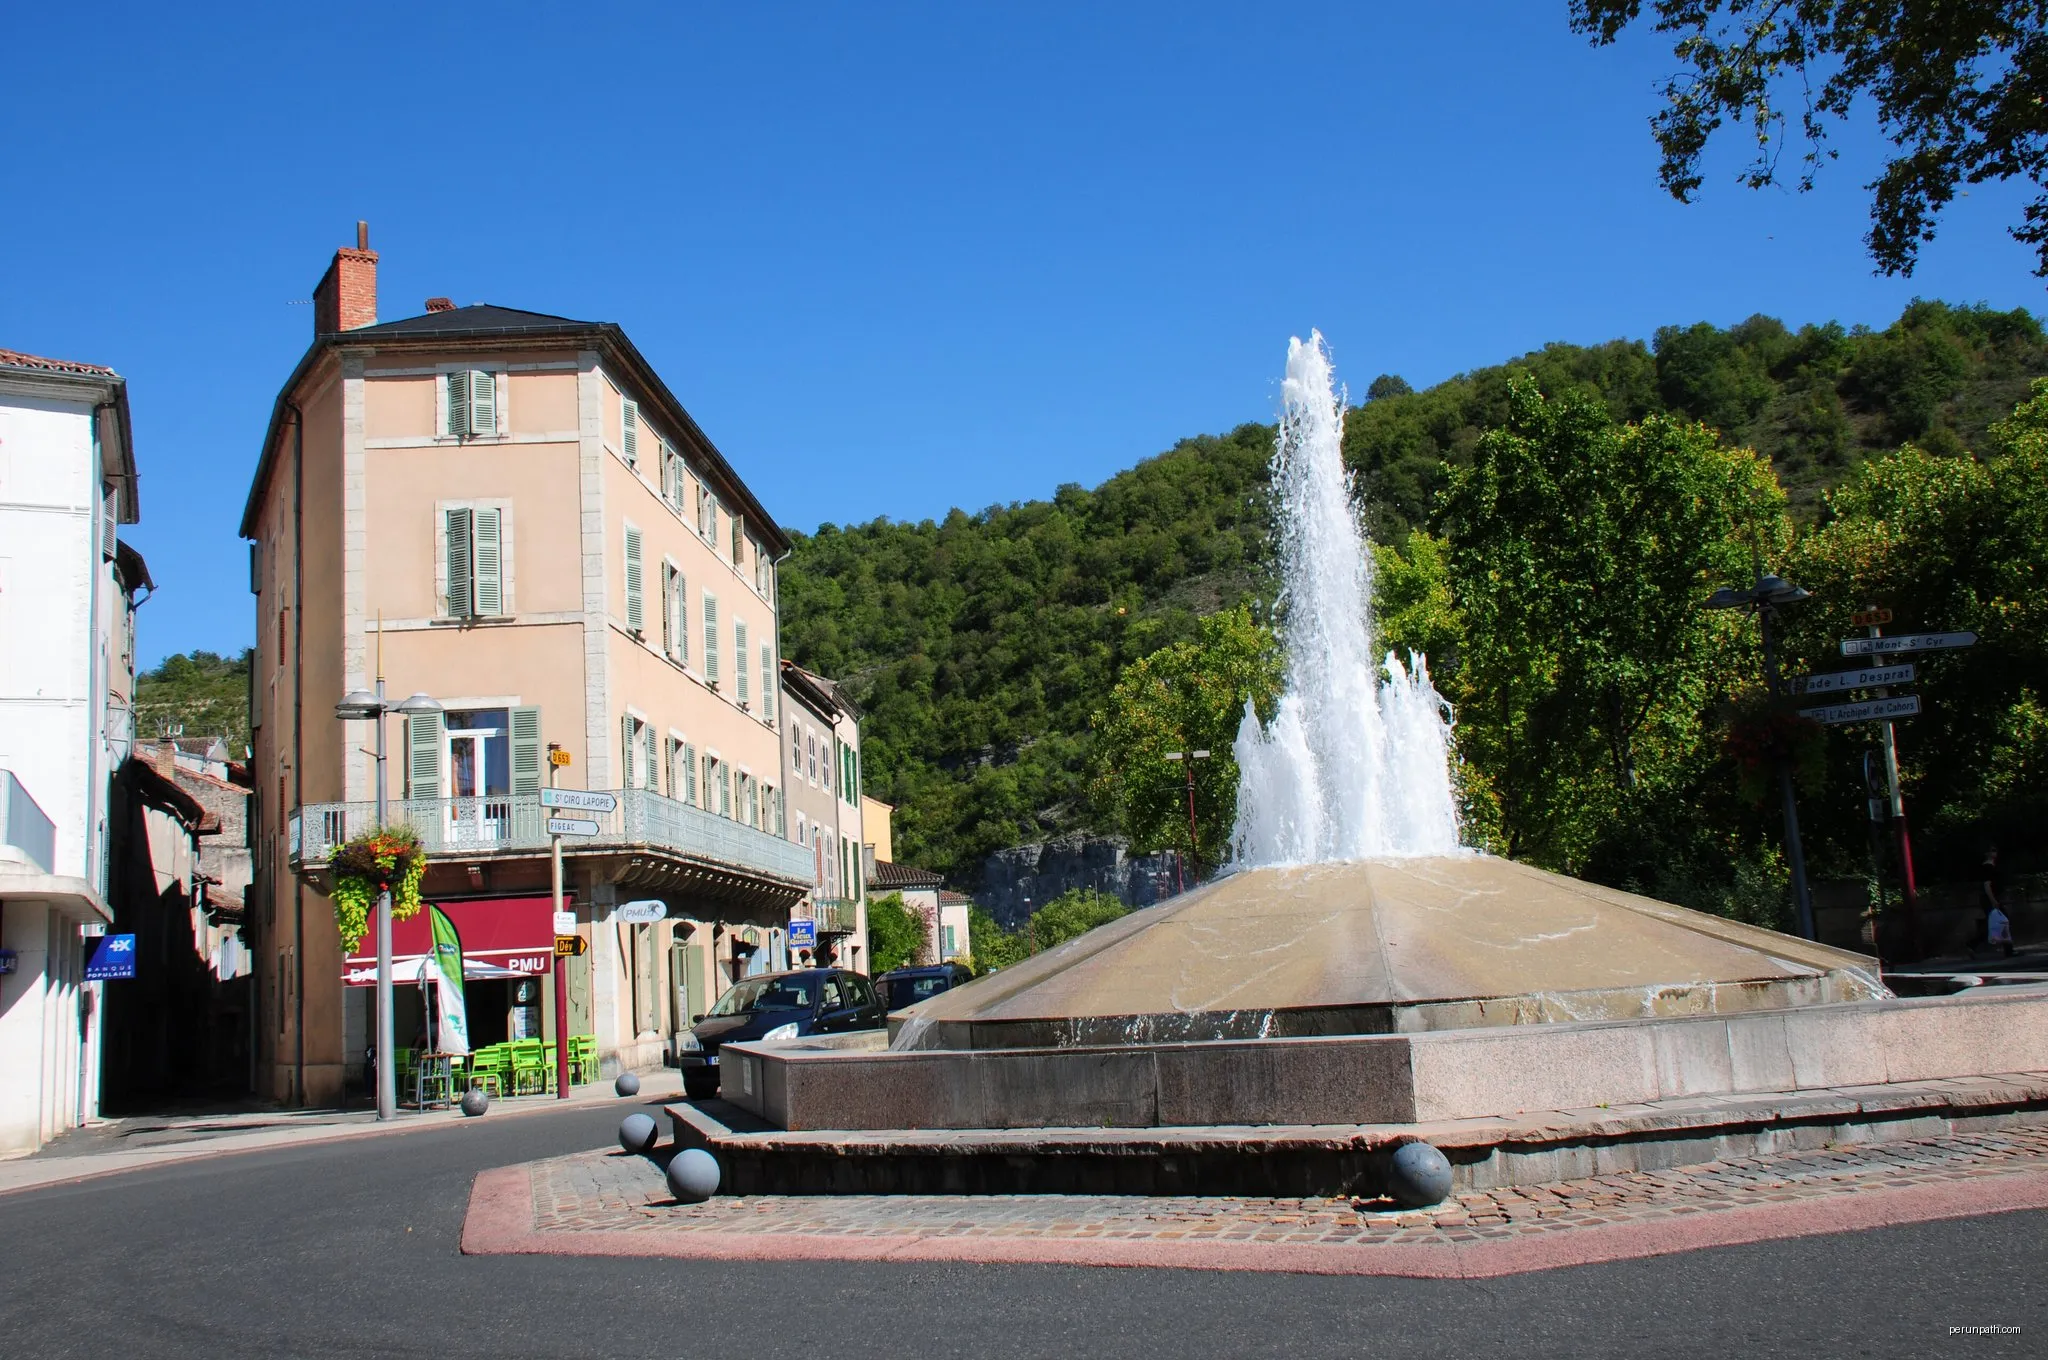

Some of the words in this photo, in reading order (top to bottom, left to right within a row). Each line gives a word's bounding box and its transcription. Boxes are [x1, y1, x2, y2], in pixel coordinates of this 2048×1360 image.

[1926, 638, 1944, 648] Cyr
[1860, 669, 1910, 683] Desprat
[1874, 704, 1884, 714] de
[1887, 701, 1914, 713] Cahors
[564, 794, 580, 805] CIRQ
[583, 797, 610, 808] LAPOPIE
[550, 822, 575, 831] FIGEAC
[626, 908, 648, 918] PMU
[508, 957, 545, 972] PMU
[87, 971, 132, 979] POPULAIRE
